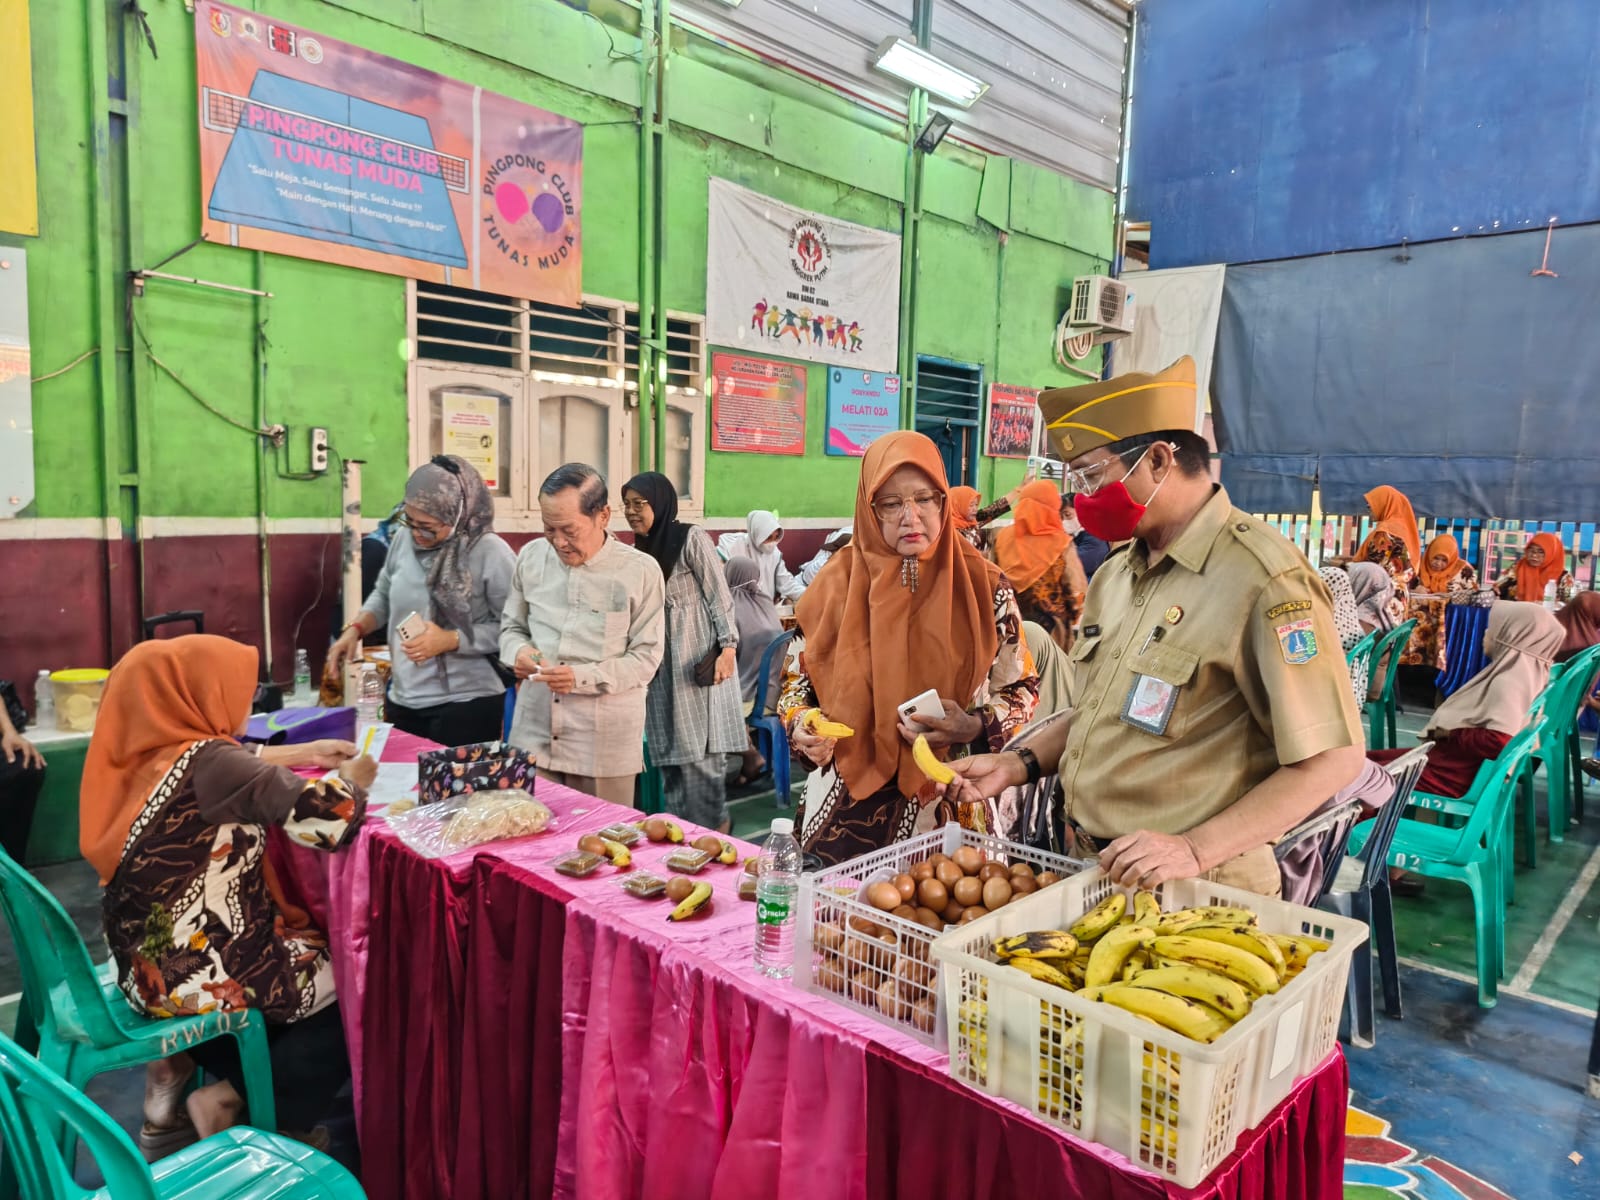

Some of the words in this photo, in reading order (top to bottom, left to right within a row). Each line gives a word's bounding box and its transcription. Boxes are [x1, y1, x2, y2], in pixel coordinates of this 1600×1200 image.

[247, 105, 377, 157] PINGPONG
[381, 143, 440, 174] CLUB
[268, 136, 353, 176] TUNAS
[357, 159, 424, 194] MUDA
[483, 154, 546, 196] PINGPONG
[551, 174, 574, 215] CLUB
[302, 176, 321, 189] Satu
[370, 193, 389, 204] Satu
[391, 199, 412, 210] Juara
[304, 194, 336, 208] dengan
[360, 206, 392, 223] Menang
[393, 215, 424, 228] dengan
[483, 214, 528, 267] TUNAS
[538, 234, 575, 270] MUDA
[841, 403, 872, 415] MELATI
[873, 406, 889, 417] 02A
[161, 1019, 206, 1055] RW
